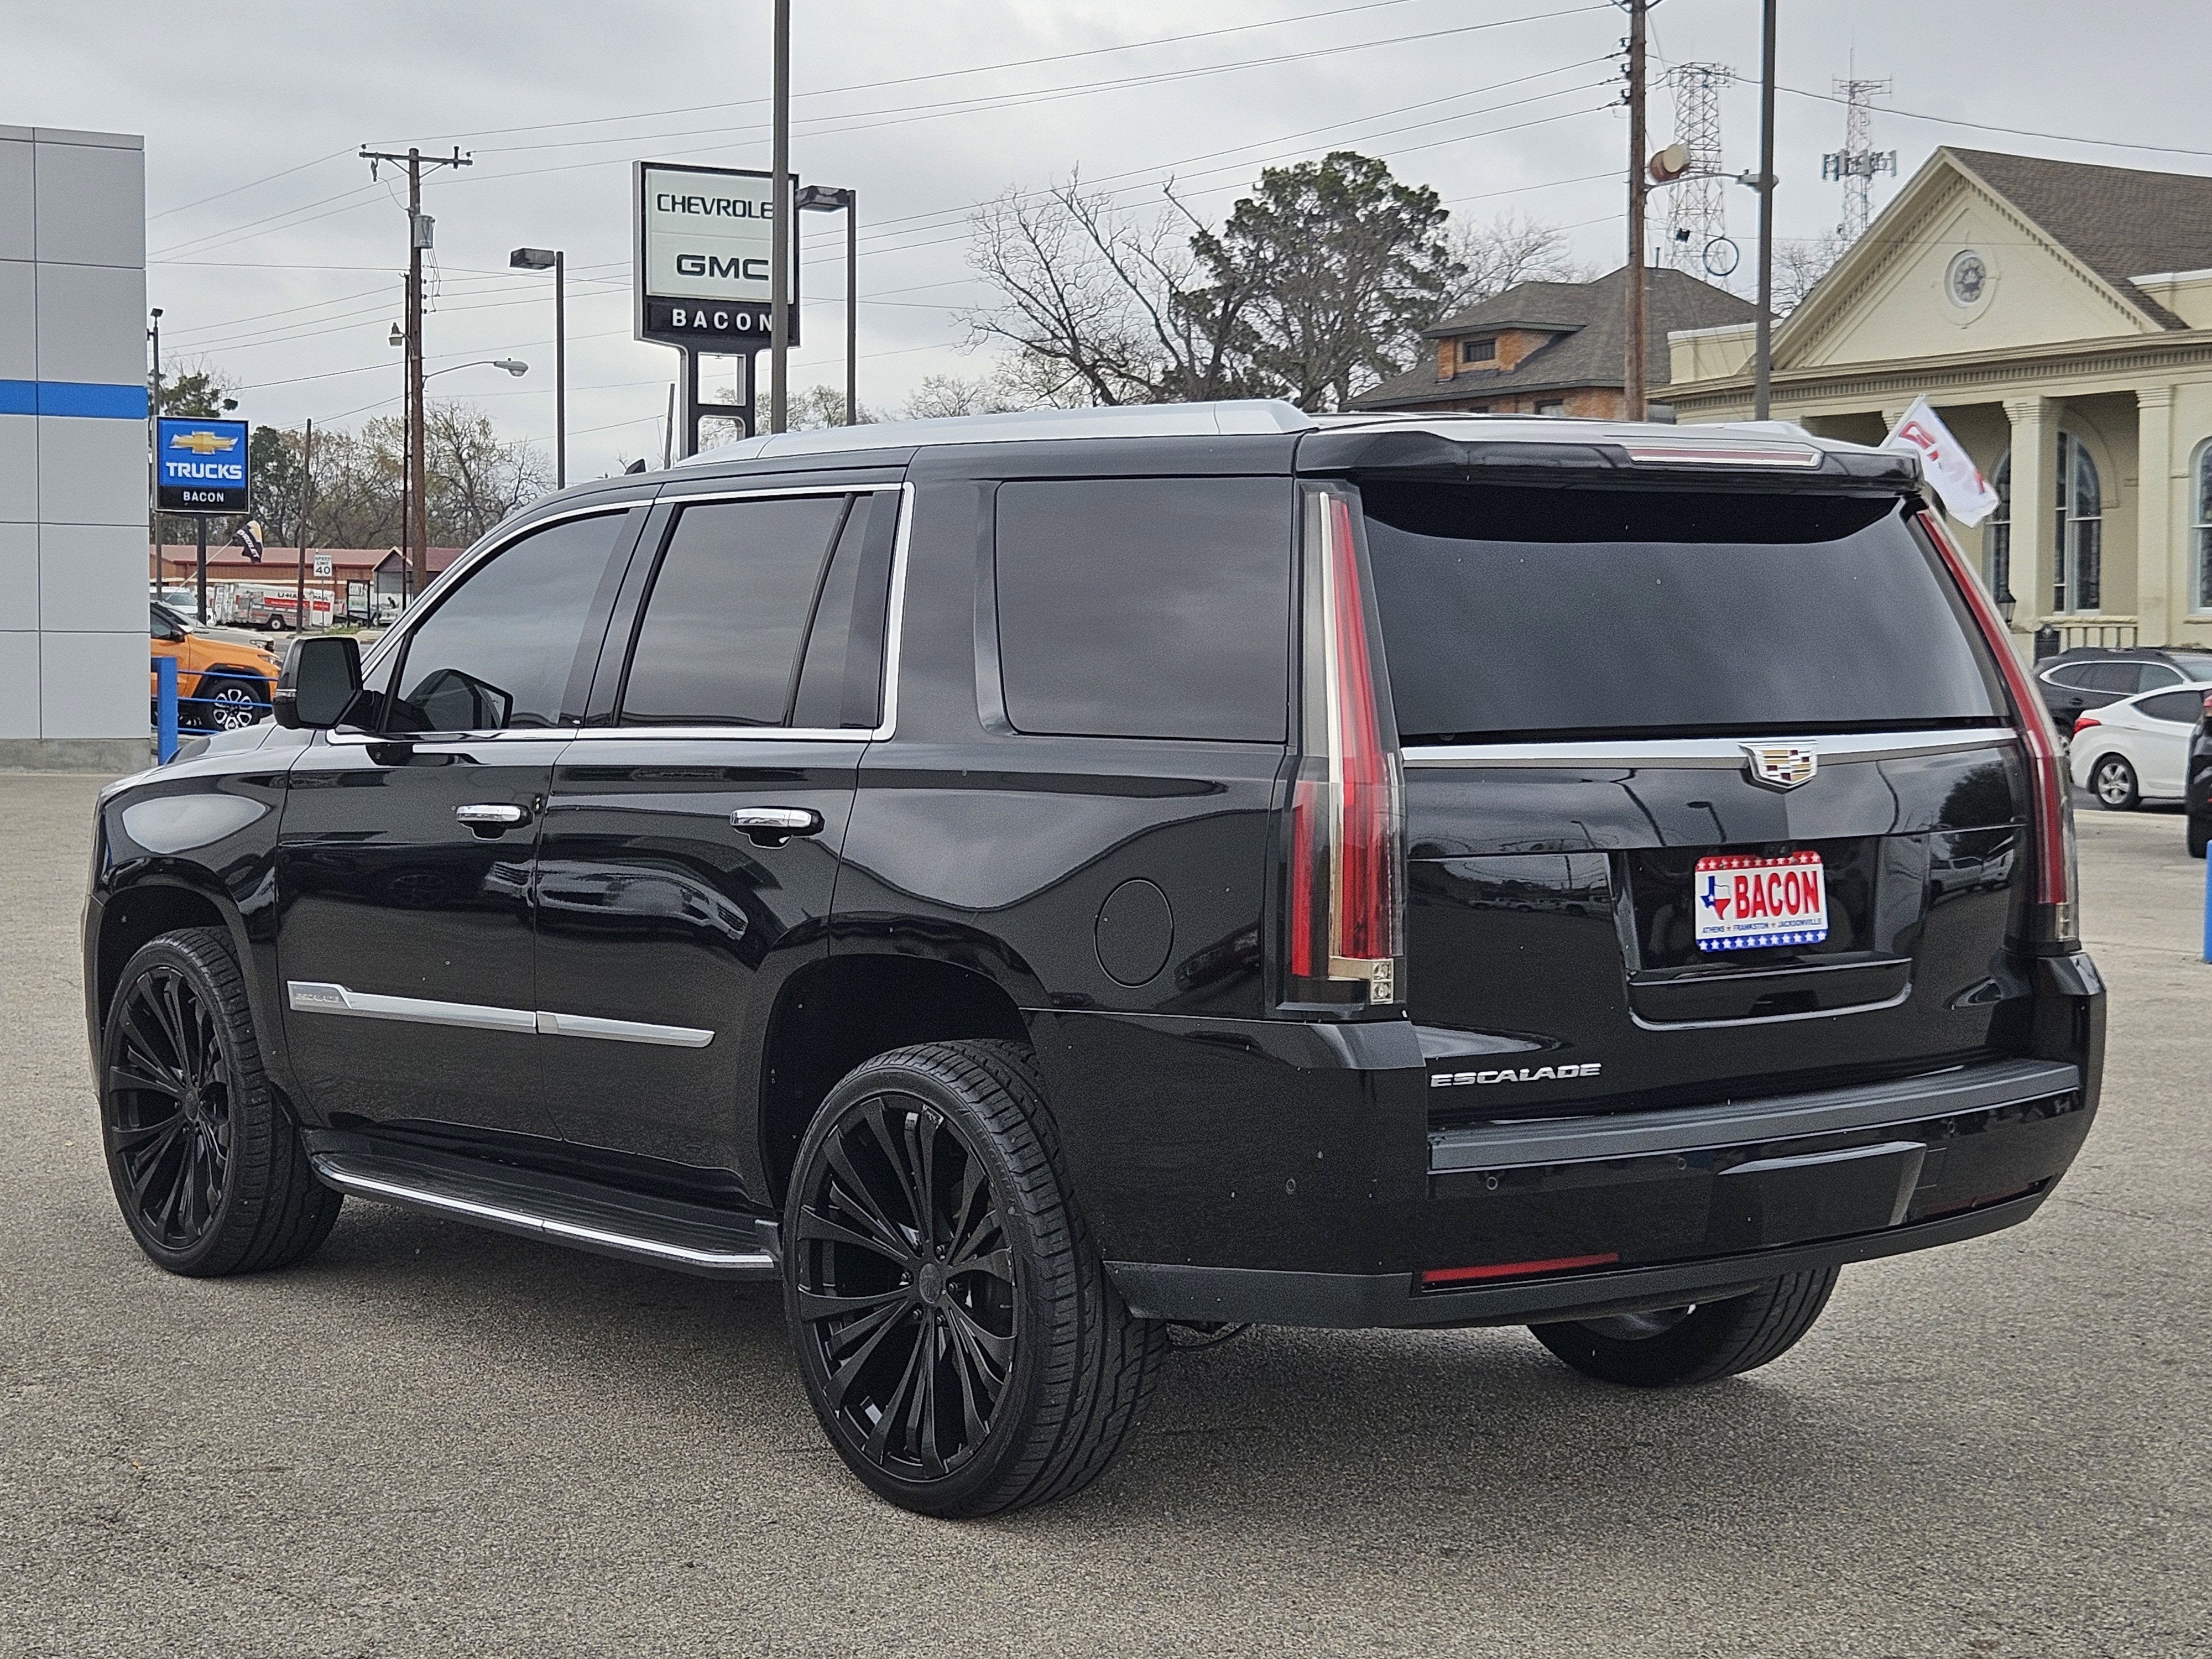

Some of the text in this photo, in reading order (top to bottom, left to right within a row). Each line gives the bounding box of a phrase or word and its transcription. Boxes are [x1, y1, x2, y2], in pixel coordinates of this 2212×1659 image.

[657, 194, 773, 220] CHEVROLE
[677, 254, 769, 281] GMC
[672, 309, 772, 332] BACON
[165, 462, 242, 479] TRUCKS
[183, 491, 225, 503] BACON
[315, 566, 331, 574] 40
[1734, 870, 1820, 920] BACON
[1702, 918, 1822, 934] ATHENS FRANKSTON JACKSONVILLE
[1430, 1062, 1602, 1087] ESCALADE
